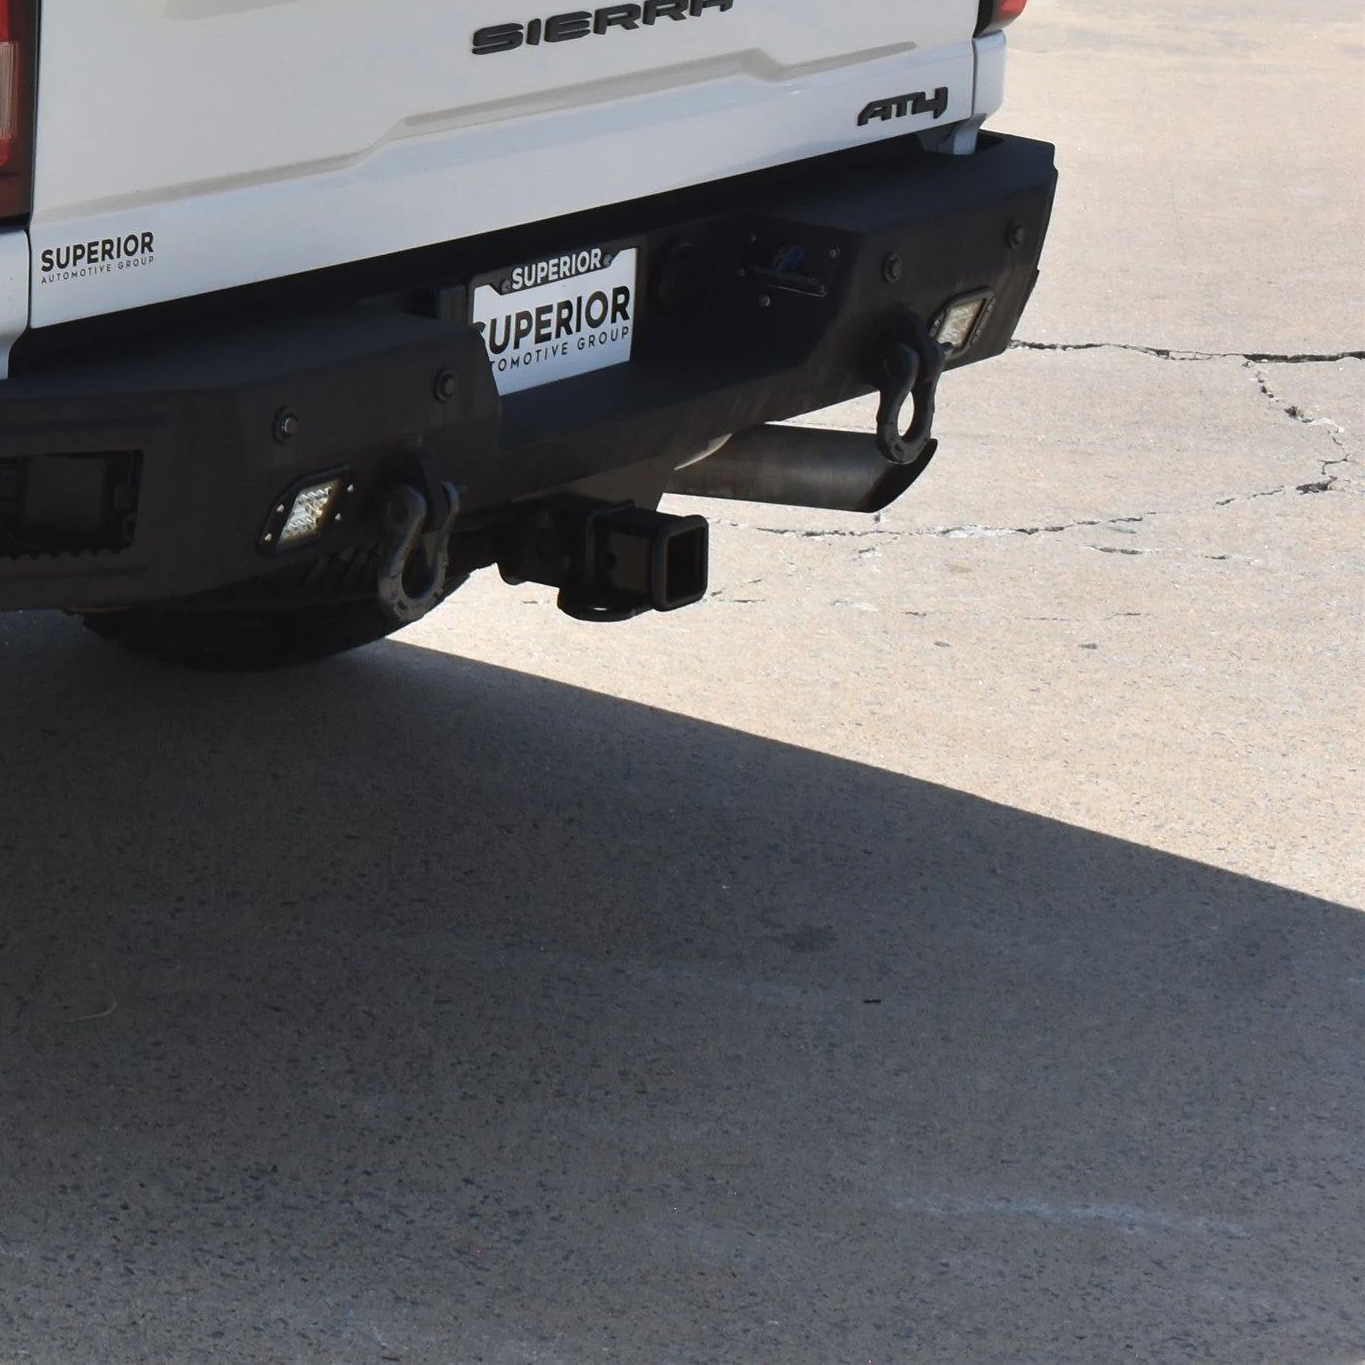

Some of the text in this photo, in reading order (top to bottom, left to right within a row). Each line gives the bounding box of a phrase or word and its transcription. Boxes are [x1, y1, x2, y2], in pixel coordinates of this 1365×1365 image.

[857, 86, 949, 127] AT4
[40, 231, 155, 272] SUPERIOR
[40, 255, 155, 284] AUTOMOTIVE GROUP
[512, 248, 602, 290] SUPERIOR
[473, 285, 631, 355] UPERIOR
[489, 326, 630, 372] TOMOTIVE GROUP
